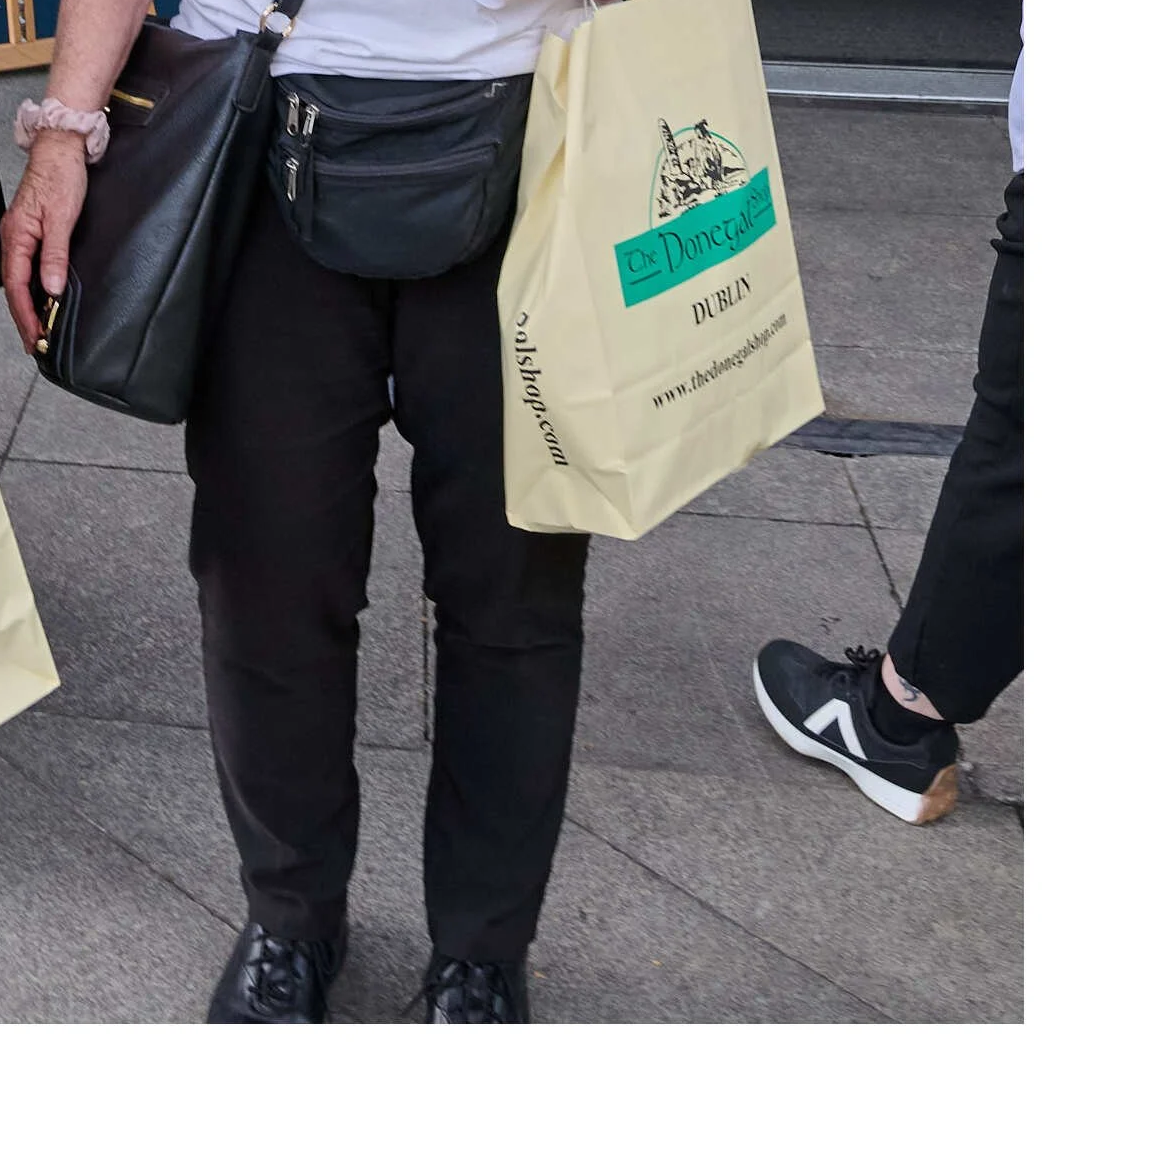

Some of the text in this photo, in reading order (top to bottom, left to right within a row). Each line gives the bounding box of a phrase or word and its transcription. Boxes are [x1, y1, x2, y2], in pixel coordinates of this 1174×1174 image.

[658, 199, 755, 274] Donegal
[692, 273, 751, 326] DUBLIN
[652, 313, 788, 411] www.thedonegalshop.com
